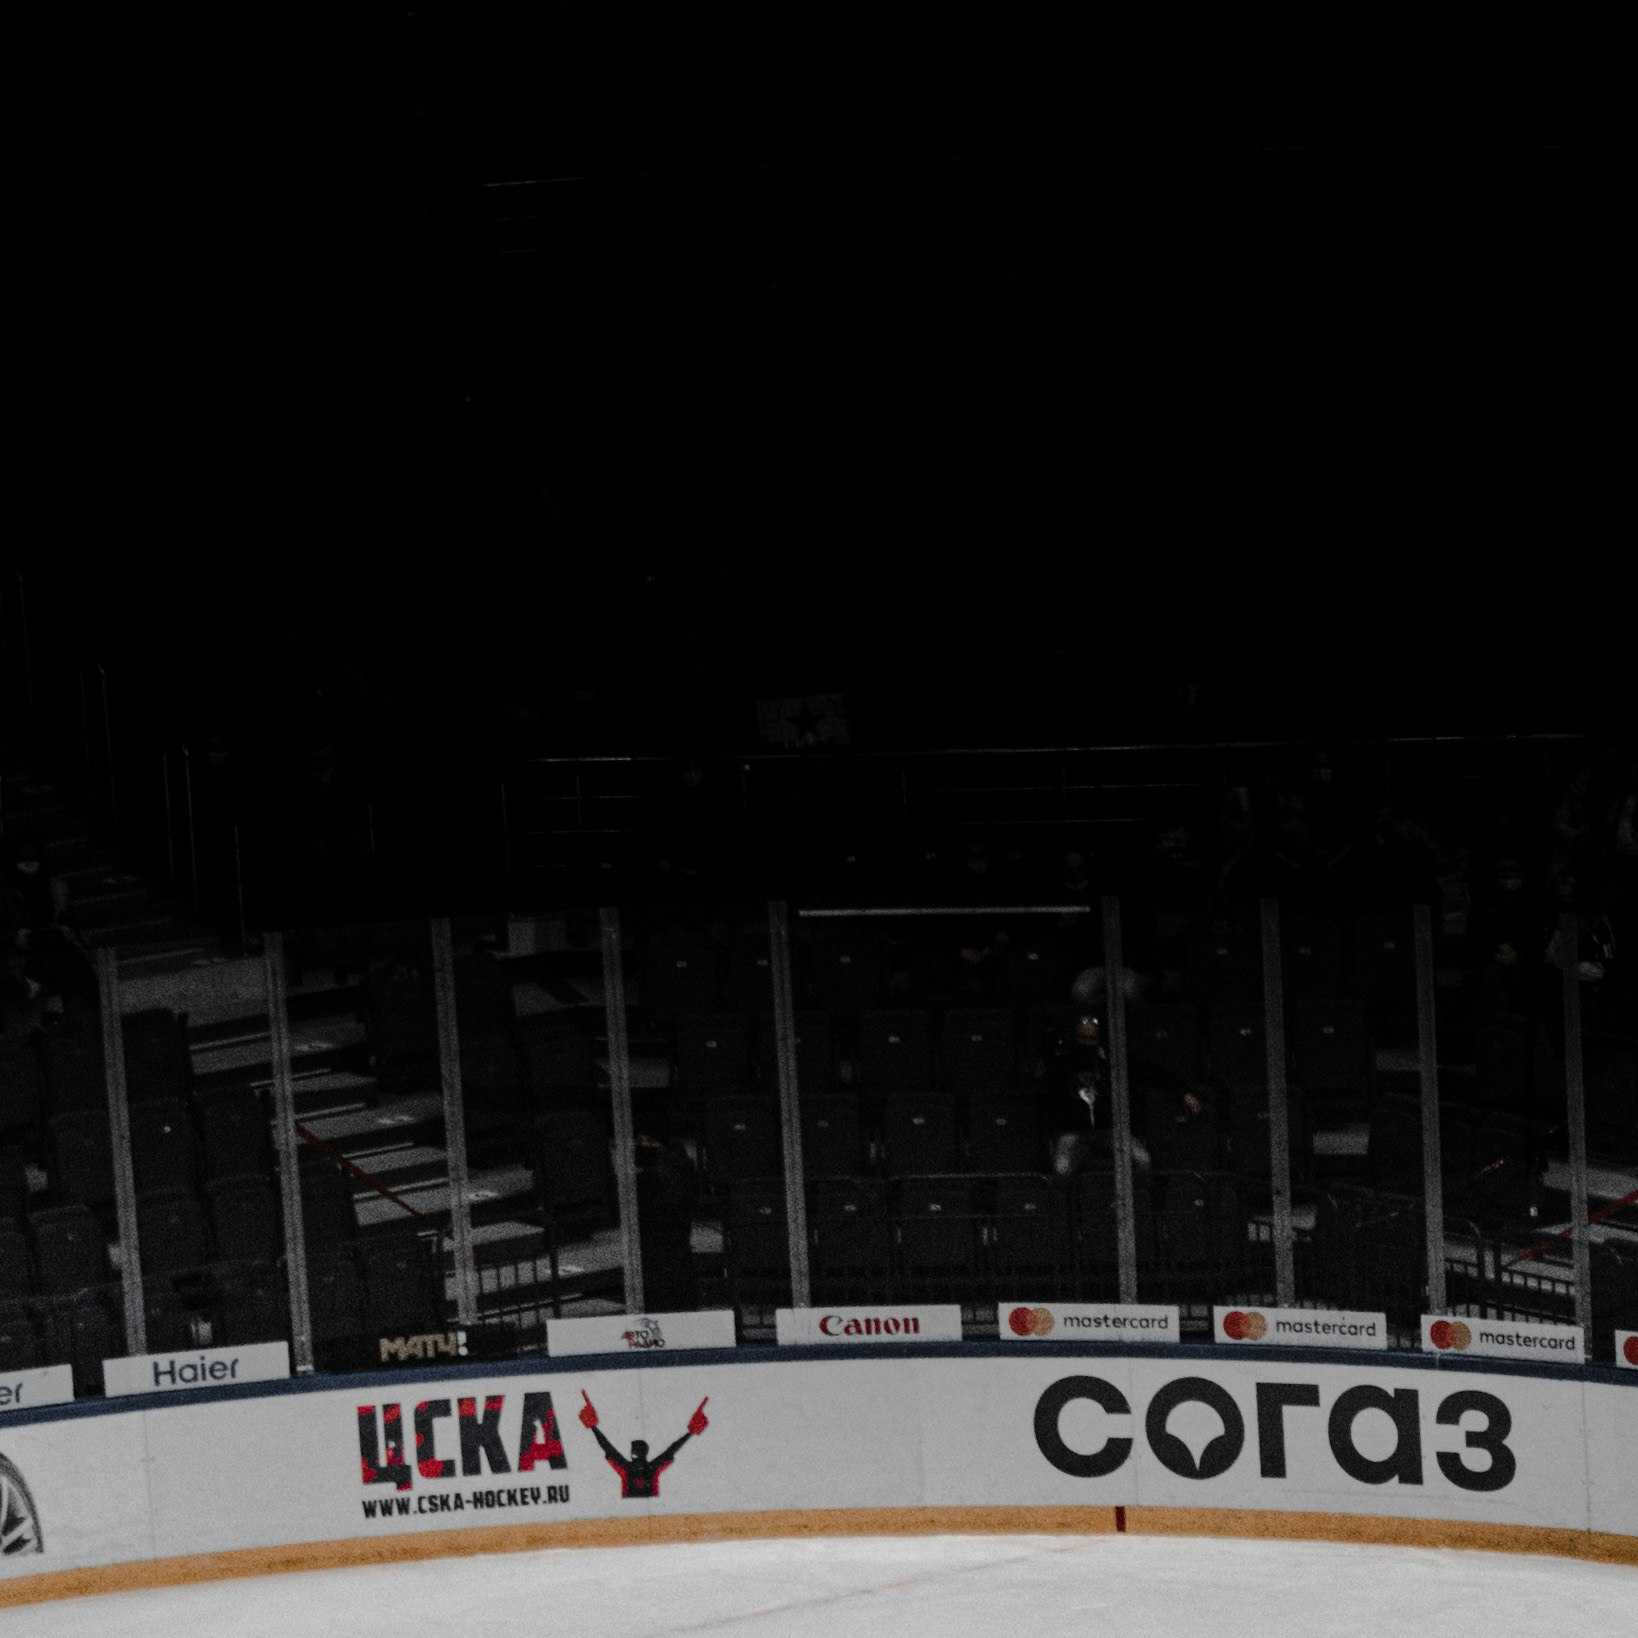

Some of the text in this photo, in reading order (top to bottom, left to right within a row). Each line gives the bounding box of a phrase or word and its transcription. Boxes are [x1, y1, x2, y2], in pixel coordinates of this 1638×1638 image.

[818, 1312, 921, 1338] Canon
[1063, 1312, 1169, 1331] mastercard
[1275, 1316, 1377, 1338] mastercard
[1479, 1328, 1577, 1352] mastercard
[152, 1356, 240, 1388] Haier
[356, 1390, 570, 1492] ЦСКА
[362, 1484, 571, 1519] WWW.CSKA-HOCKEY.RU
